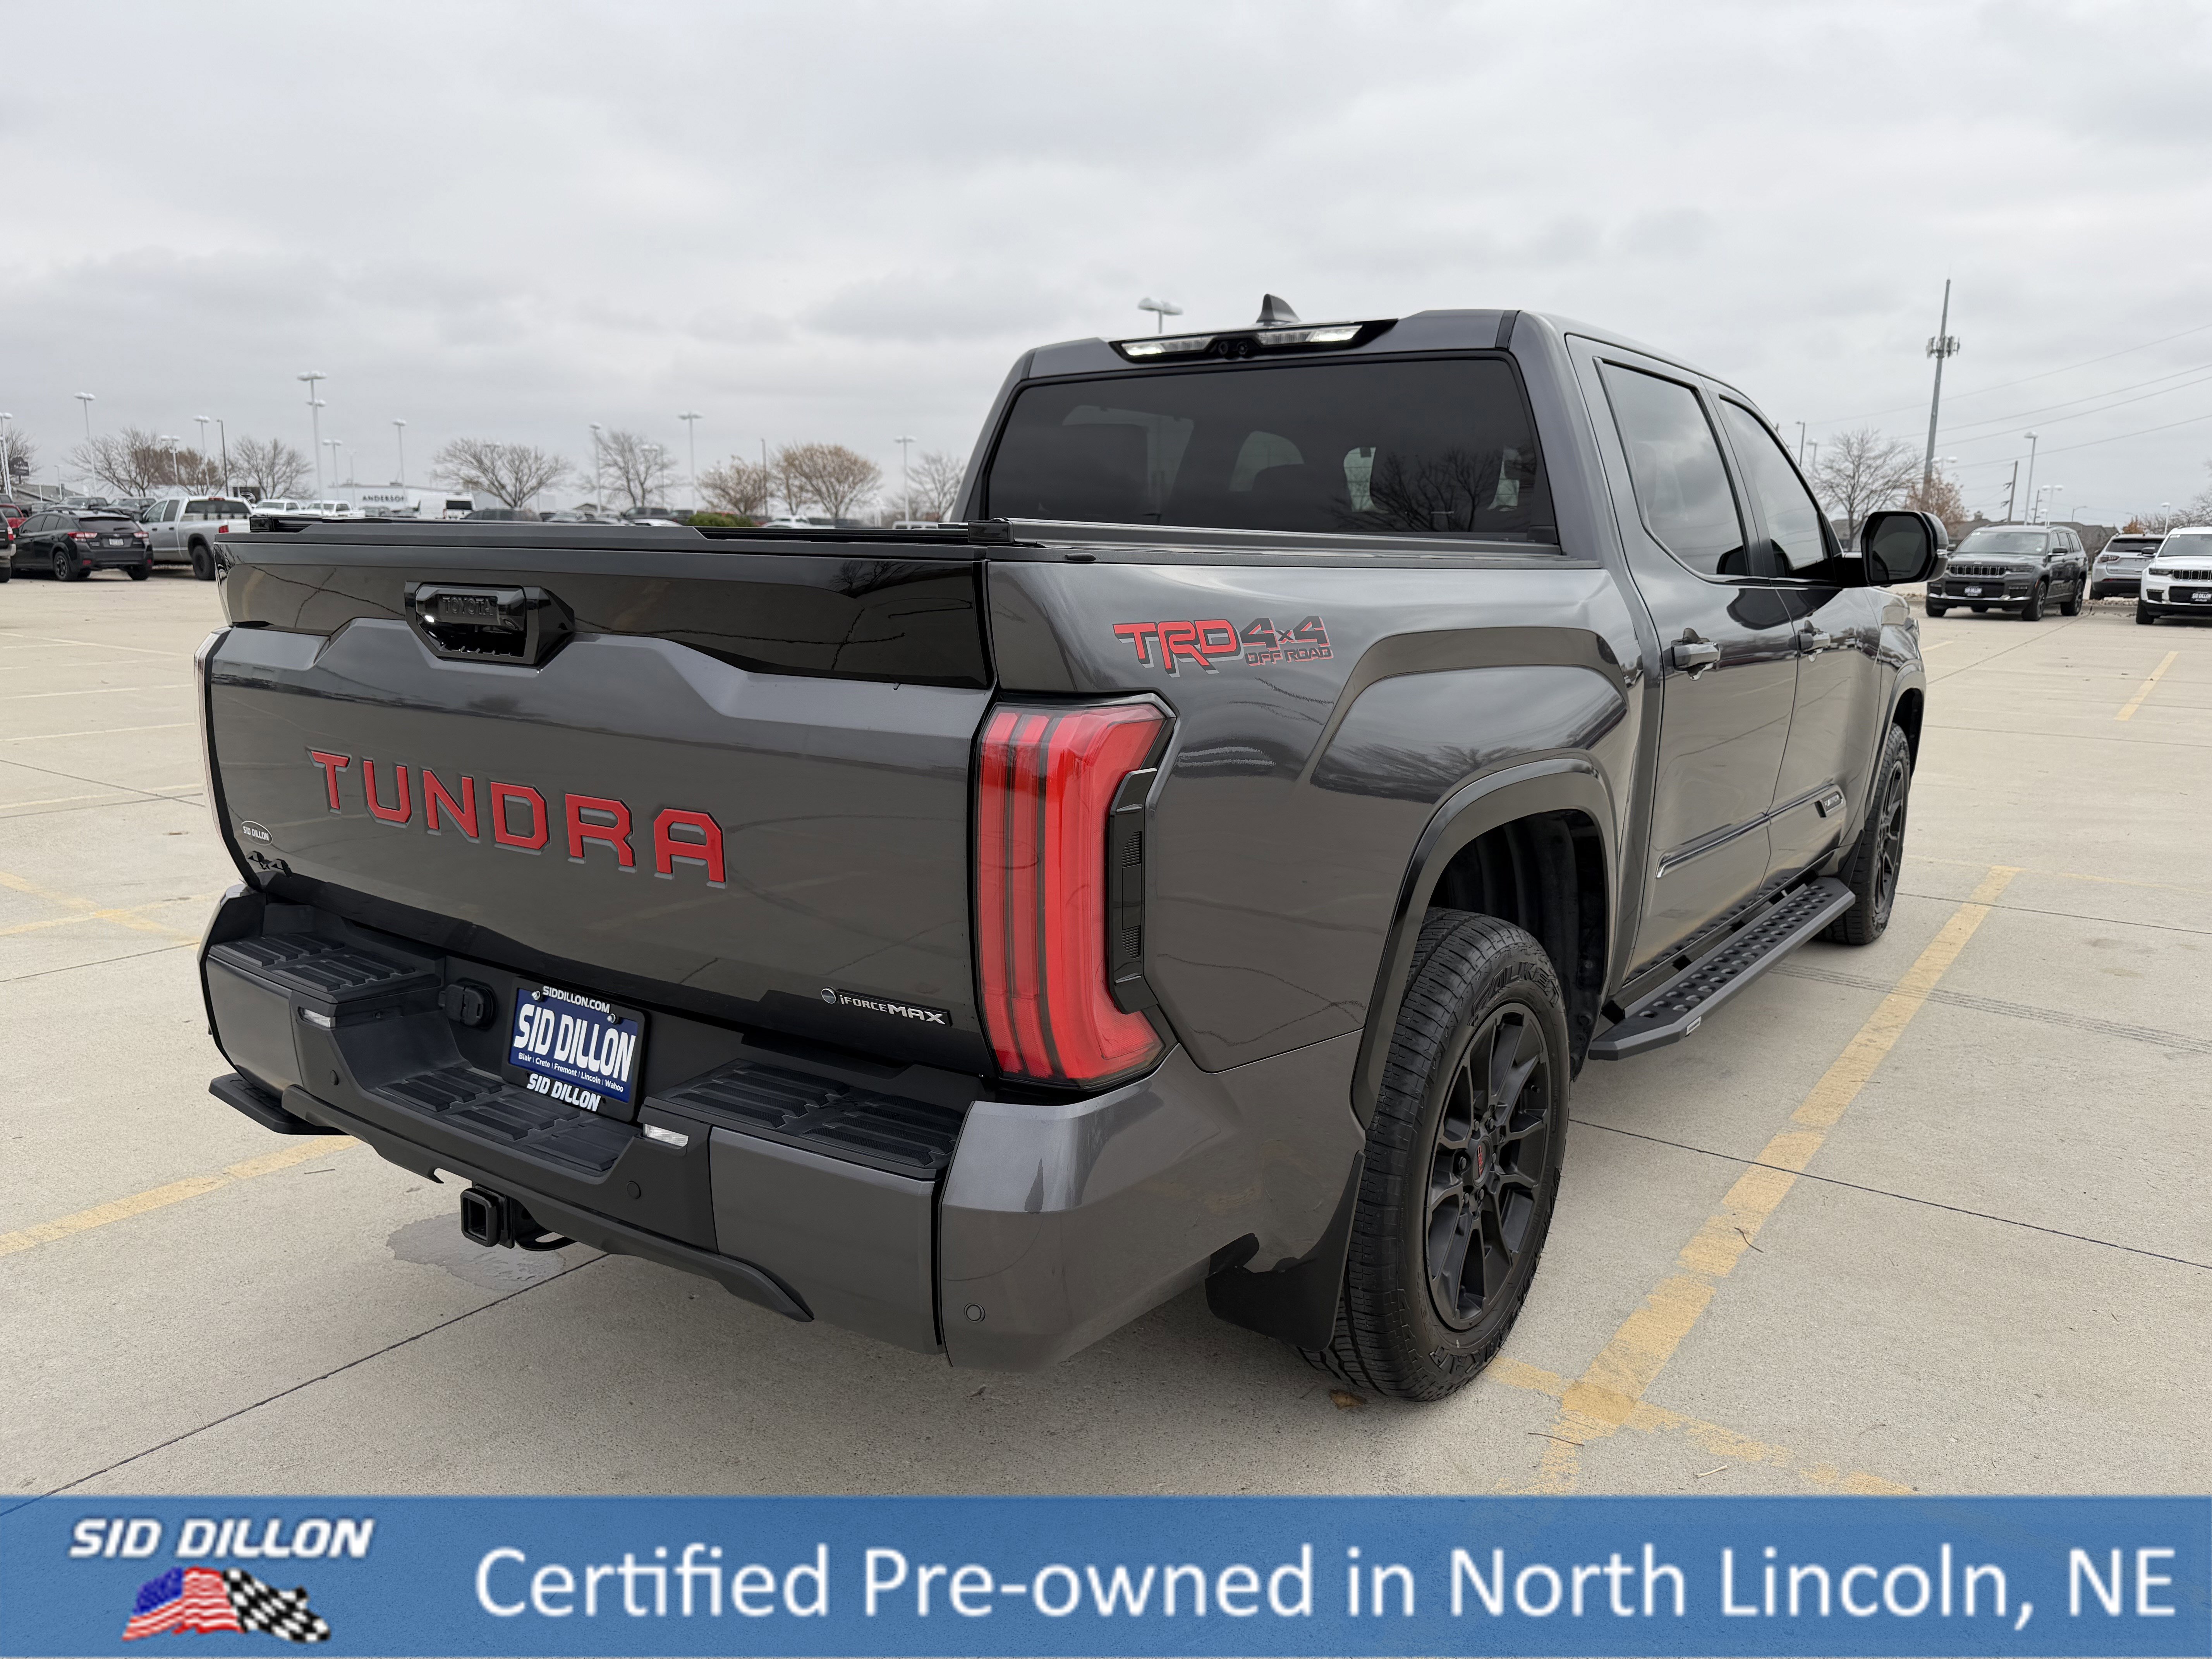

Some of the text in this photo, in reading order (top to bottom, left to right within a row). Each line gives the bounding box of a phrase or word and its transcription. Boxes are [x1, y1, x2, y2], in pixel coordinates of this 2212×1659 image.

[442, 596, 493, 616] TOYOTA
[1113, 619, 1242, 675] TRD
[1245, 646, 1334, 666] OFF ROAD
[243, 826, 269, 841] SID DILLON
[308, 749, 727, 886] TUNDRA
[543, 986, 610, 1013] SIDDILLON.COM
[514, 1003, 636, 1082] SID DILLON
[519, 1053, 624, 1092] Blair Crete Fremont Lincoln Wahoo
[527, 1073, 601, 1112] SID DILLON
